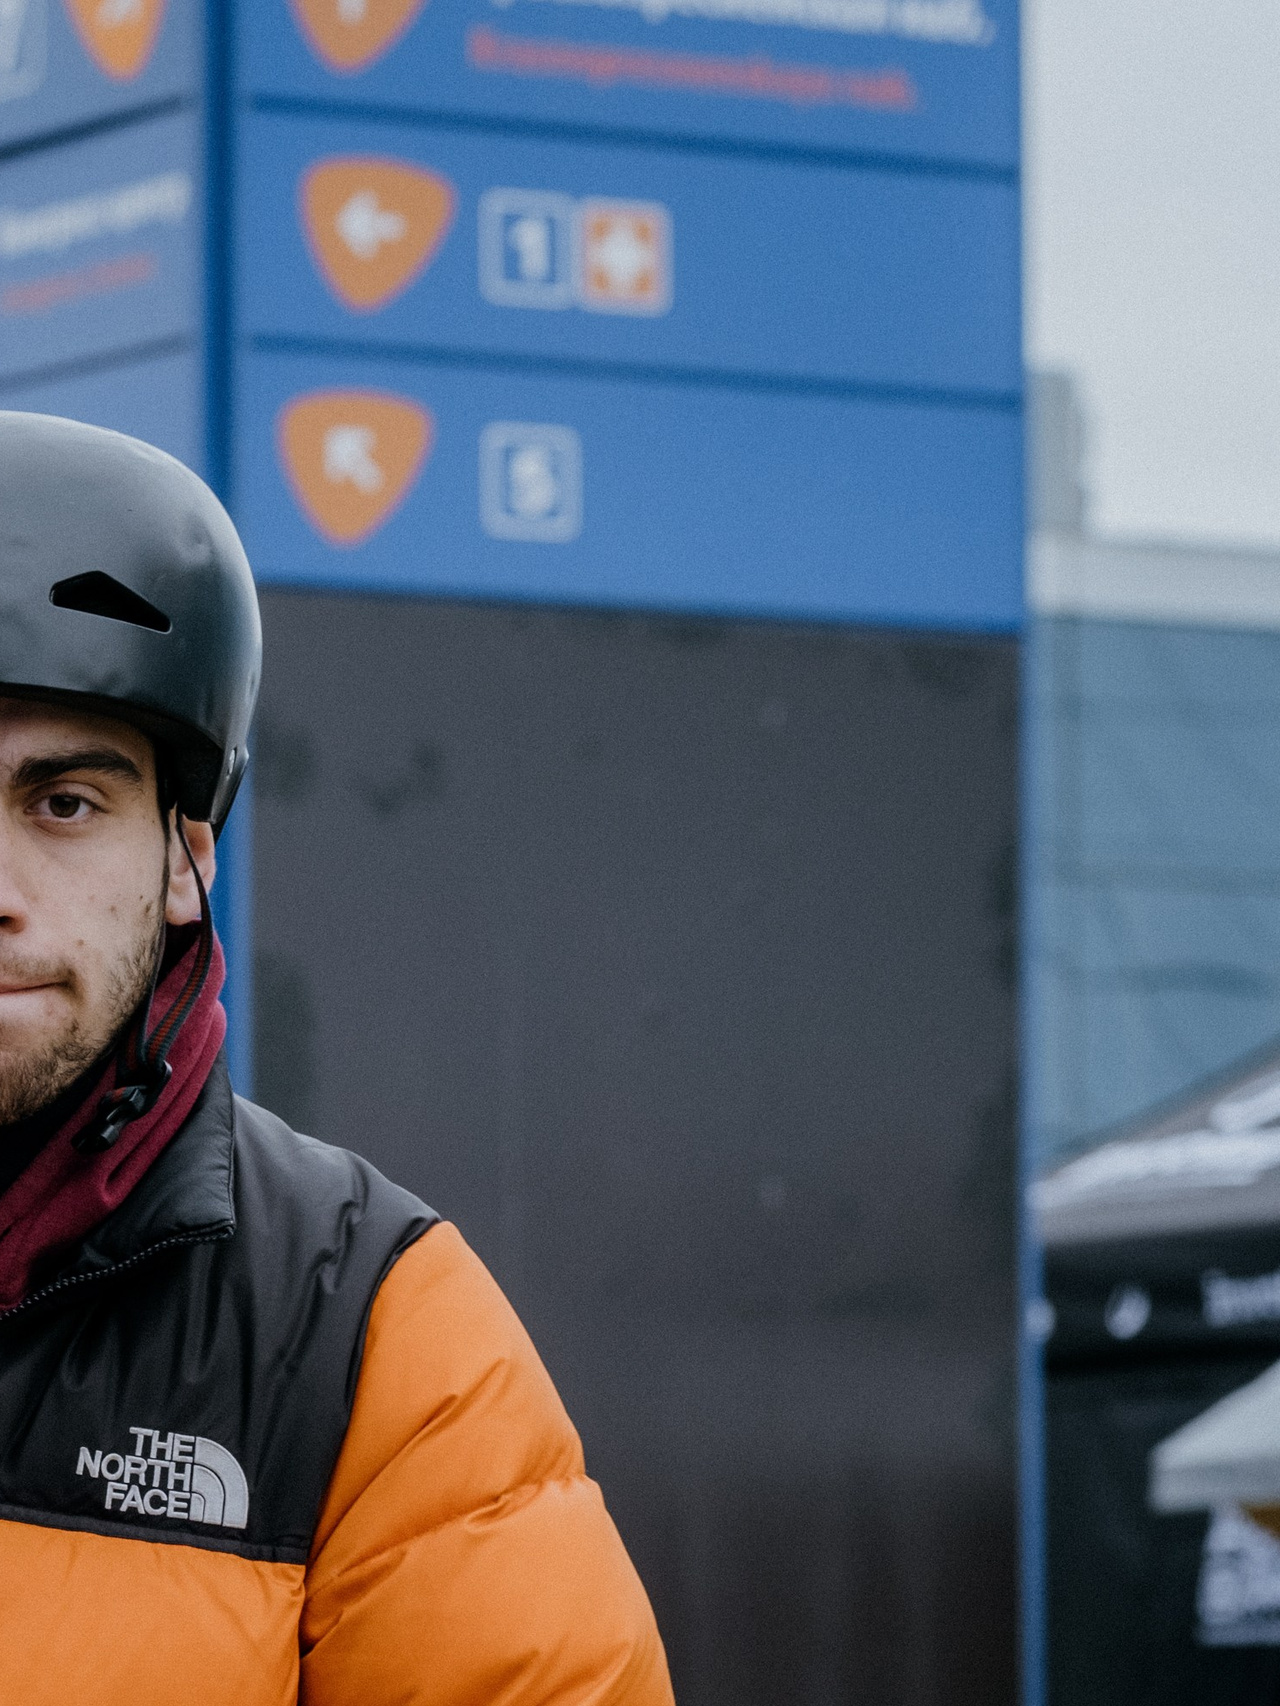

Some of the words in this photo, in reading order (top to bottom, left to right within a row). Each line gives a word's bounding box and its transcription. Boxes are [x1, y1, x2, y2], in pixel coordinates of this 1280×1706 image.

[129, 1426, 196, 1463] THE
[76, 1446, 192, 1492] NORTH
[105, 1482, 191, 1520] FACE
